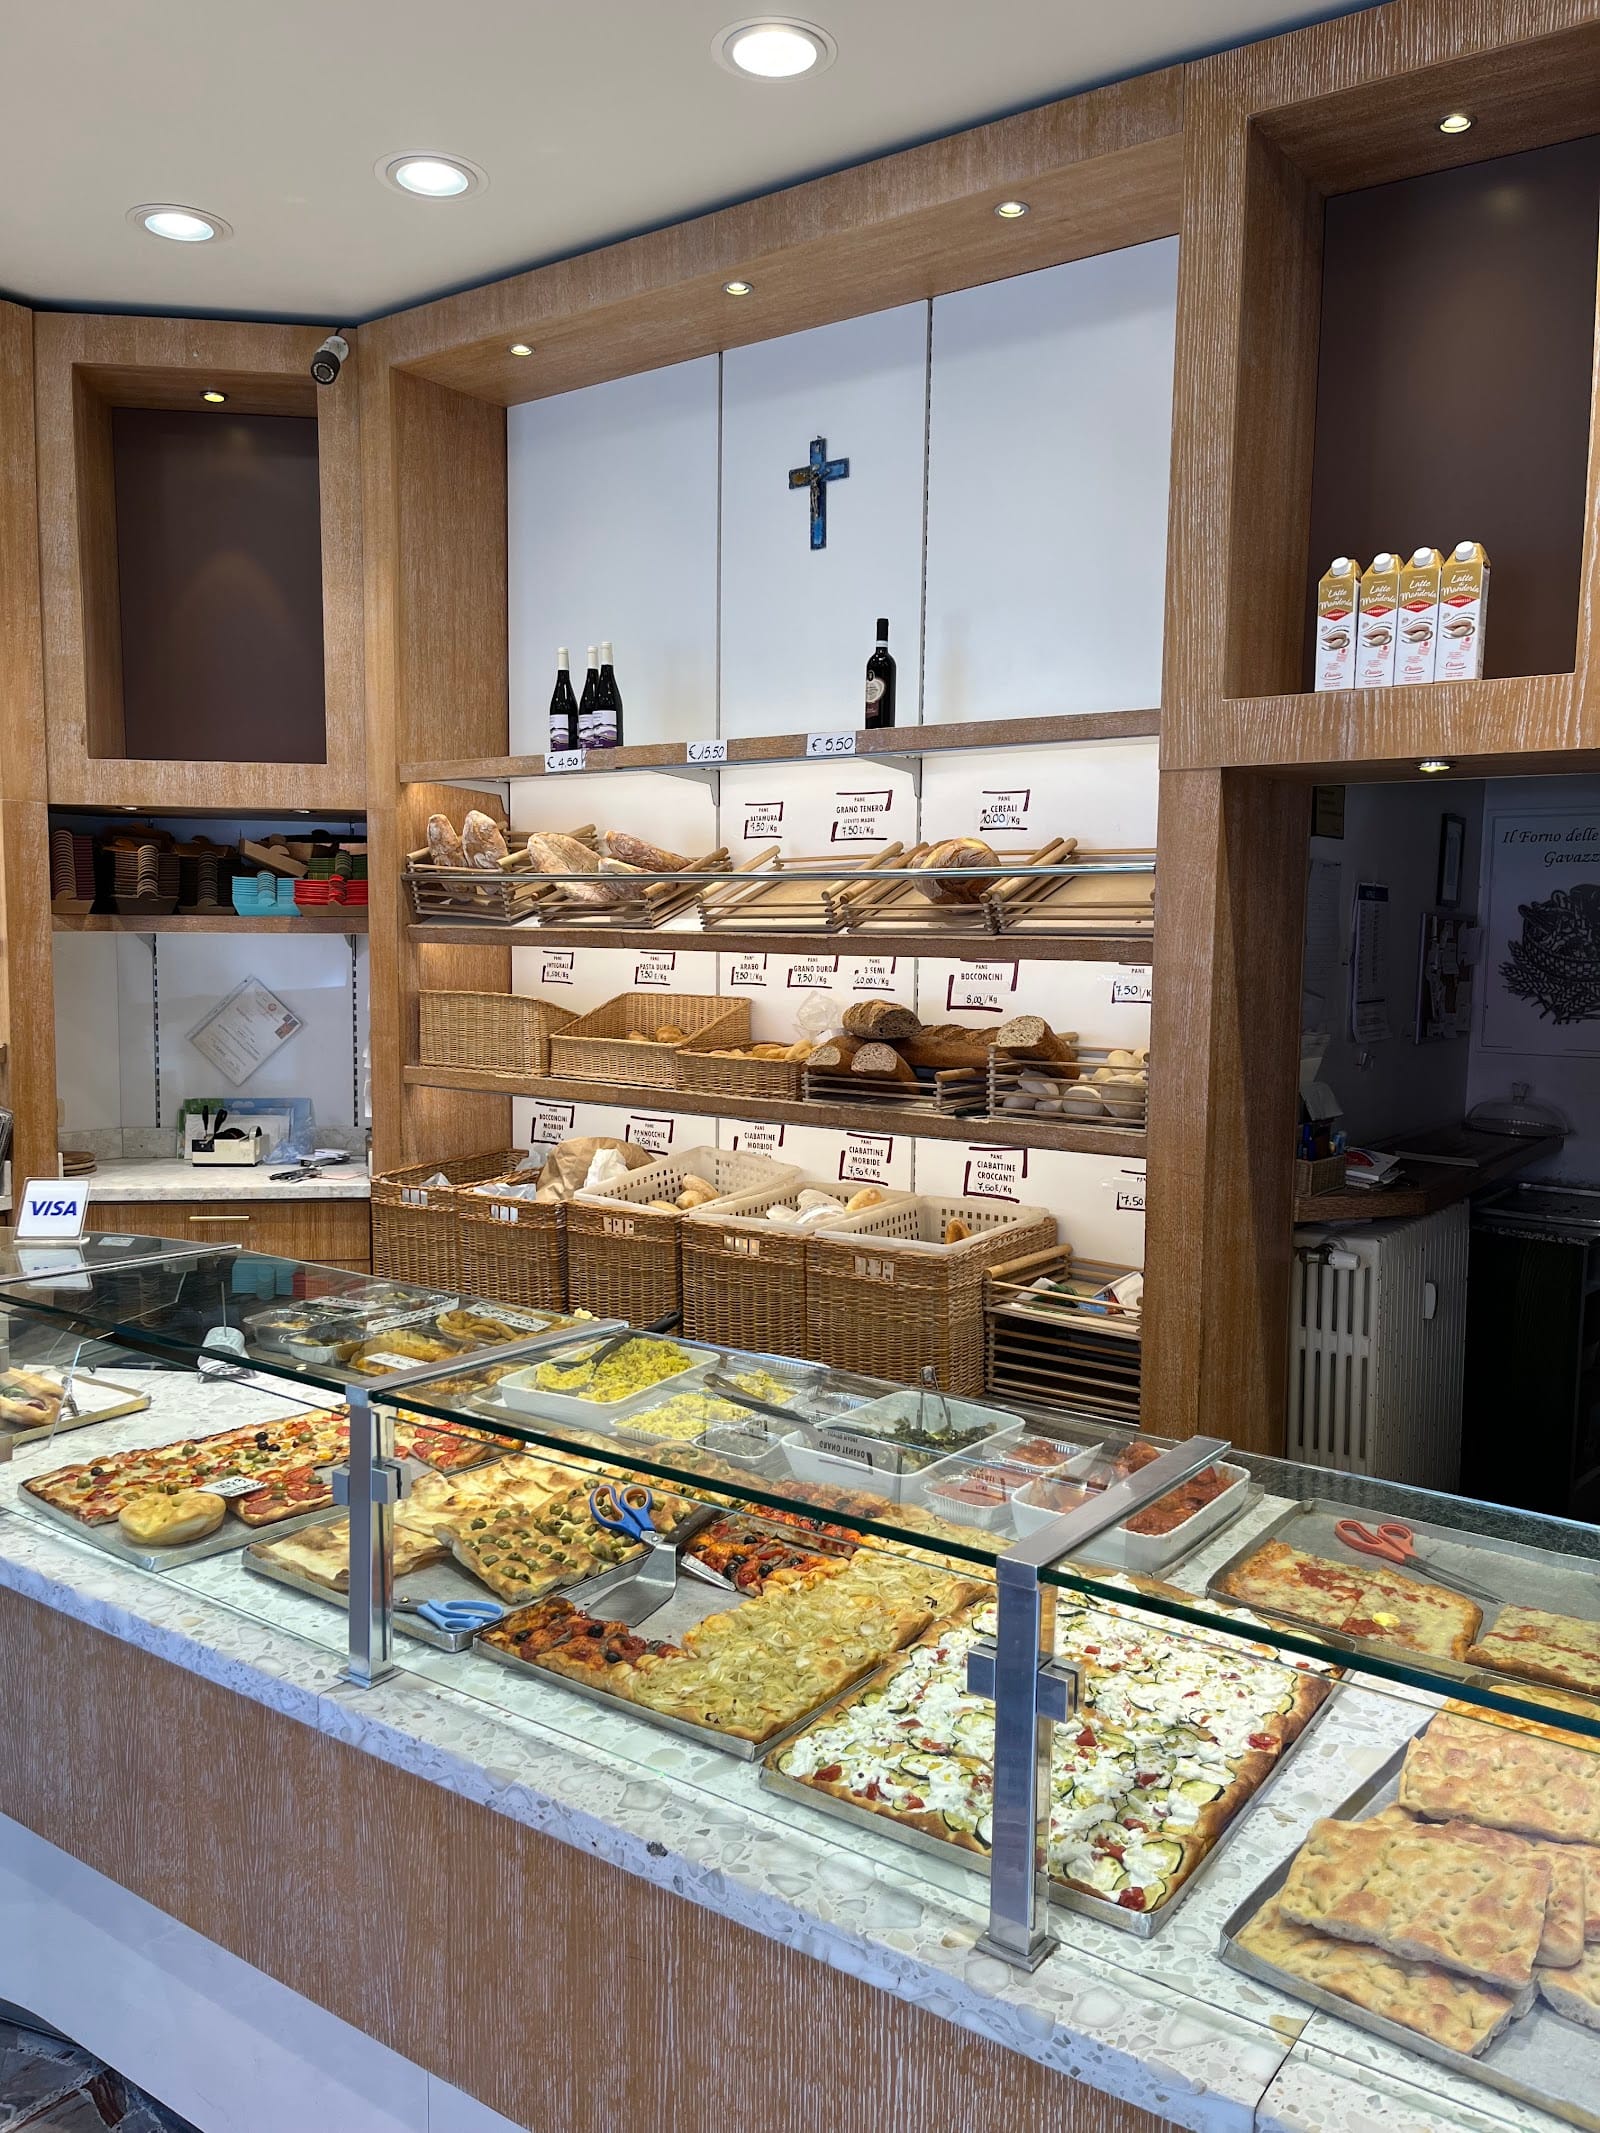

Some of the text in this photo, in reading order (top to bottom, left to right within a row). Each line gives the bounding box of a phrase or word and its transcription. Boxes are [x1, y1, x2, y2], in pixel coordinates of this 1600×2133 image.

[1451, 574, 1474, 584] Latte
[1369, 585, 1391, 594] Latte
[1409, 580, 1431, 589] Latte
[1327, 588, 1347, 598] Latte
[836, 804, 884, 814] GRANO TENERO
[990, 804, 1018, 813] CEREALI
[750, 814, 778, 822] ALTAMURA
[1503, 827, 1599, 844] Il Forno delle
[793, 965, 833, 973] GRANO DURO
[870, 966, 885, 974] SEMI
[960, 972, 1003, 981] BOCCONCINI
[539, 1113, 567, 1122] BOCCONCINI
[543, 1122, 564, 1131] MORBIDI
[633, 1129, 666, 1139] PANNOCCHIE
[744, 1132, 776, 1141] CIABATTINE
[747, 1141, 773, 1151] MORBIDE
[849, 1146, 884, 1157] CIABATTINE
[852, 1156, 881, 1167] MORBIDE
[976, 1160, 1016, 1172] CIABATTINE
[977, 1171, 1015, 1183] CROCCANTI
[27, 1200, 77, 1216] VISA
